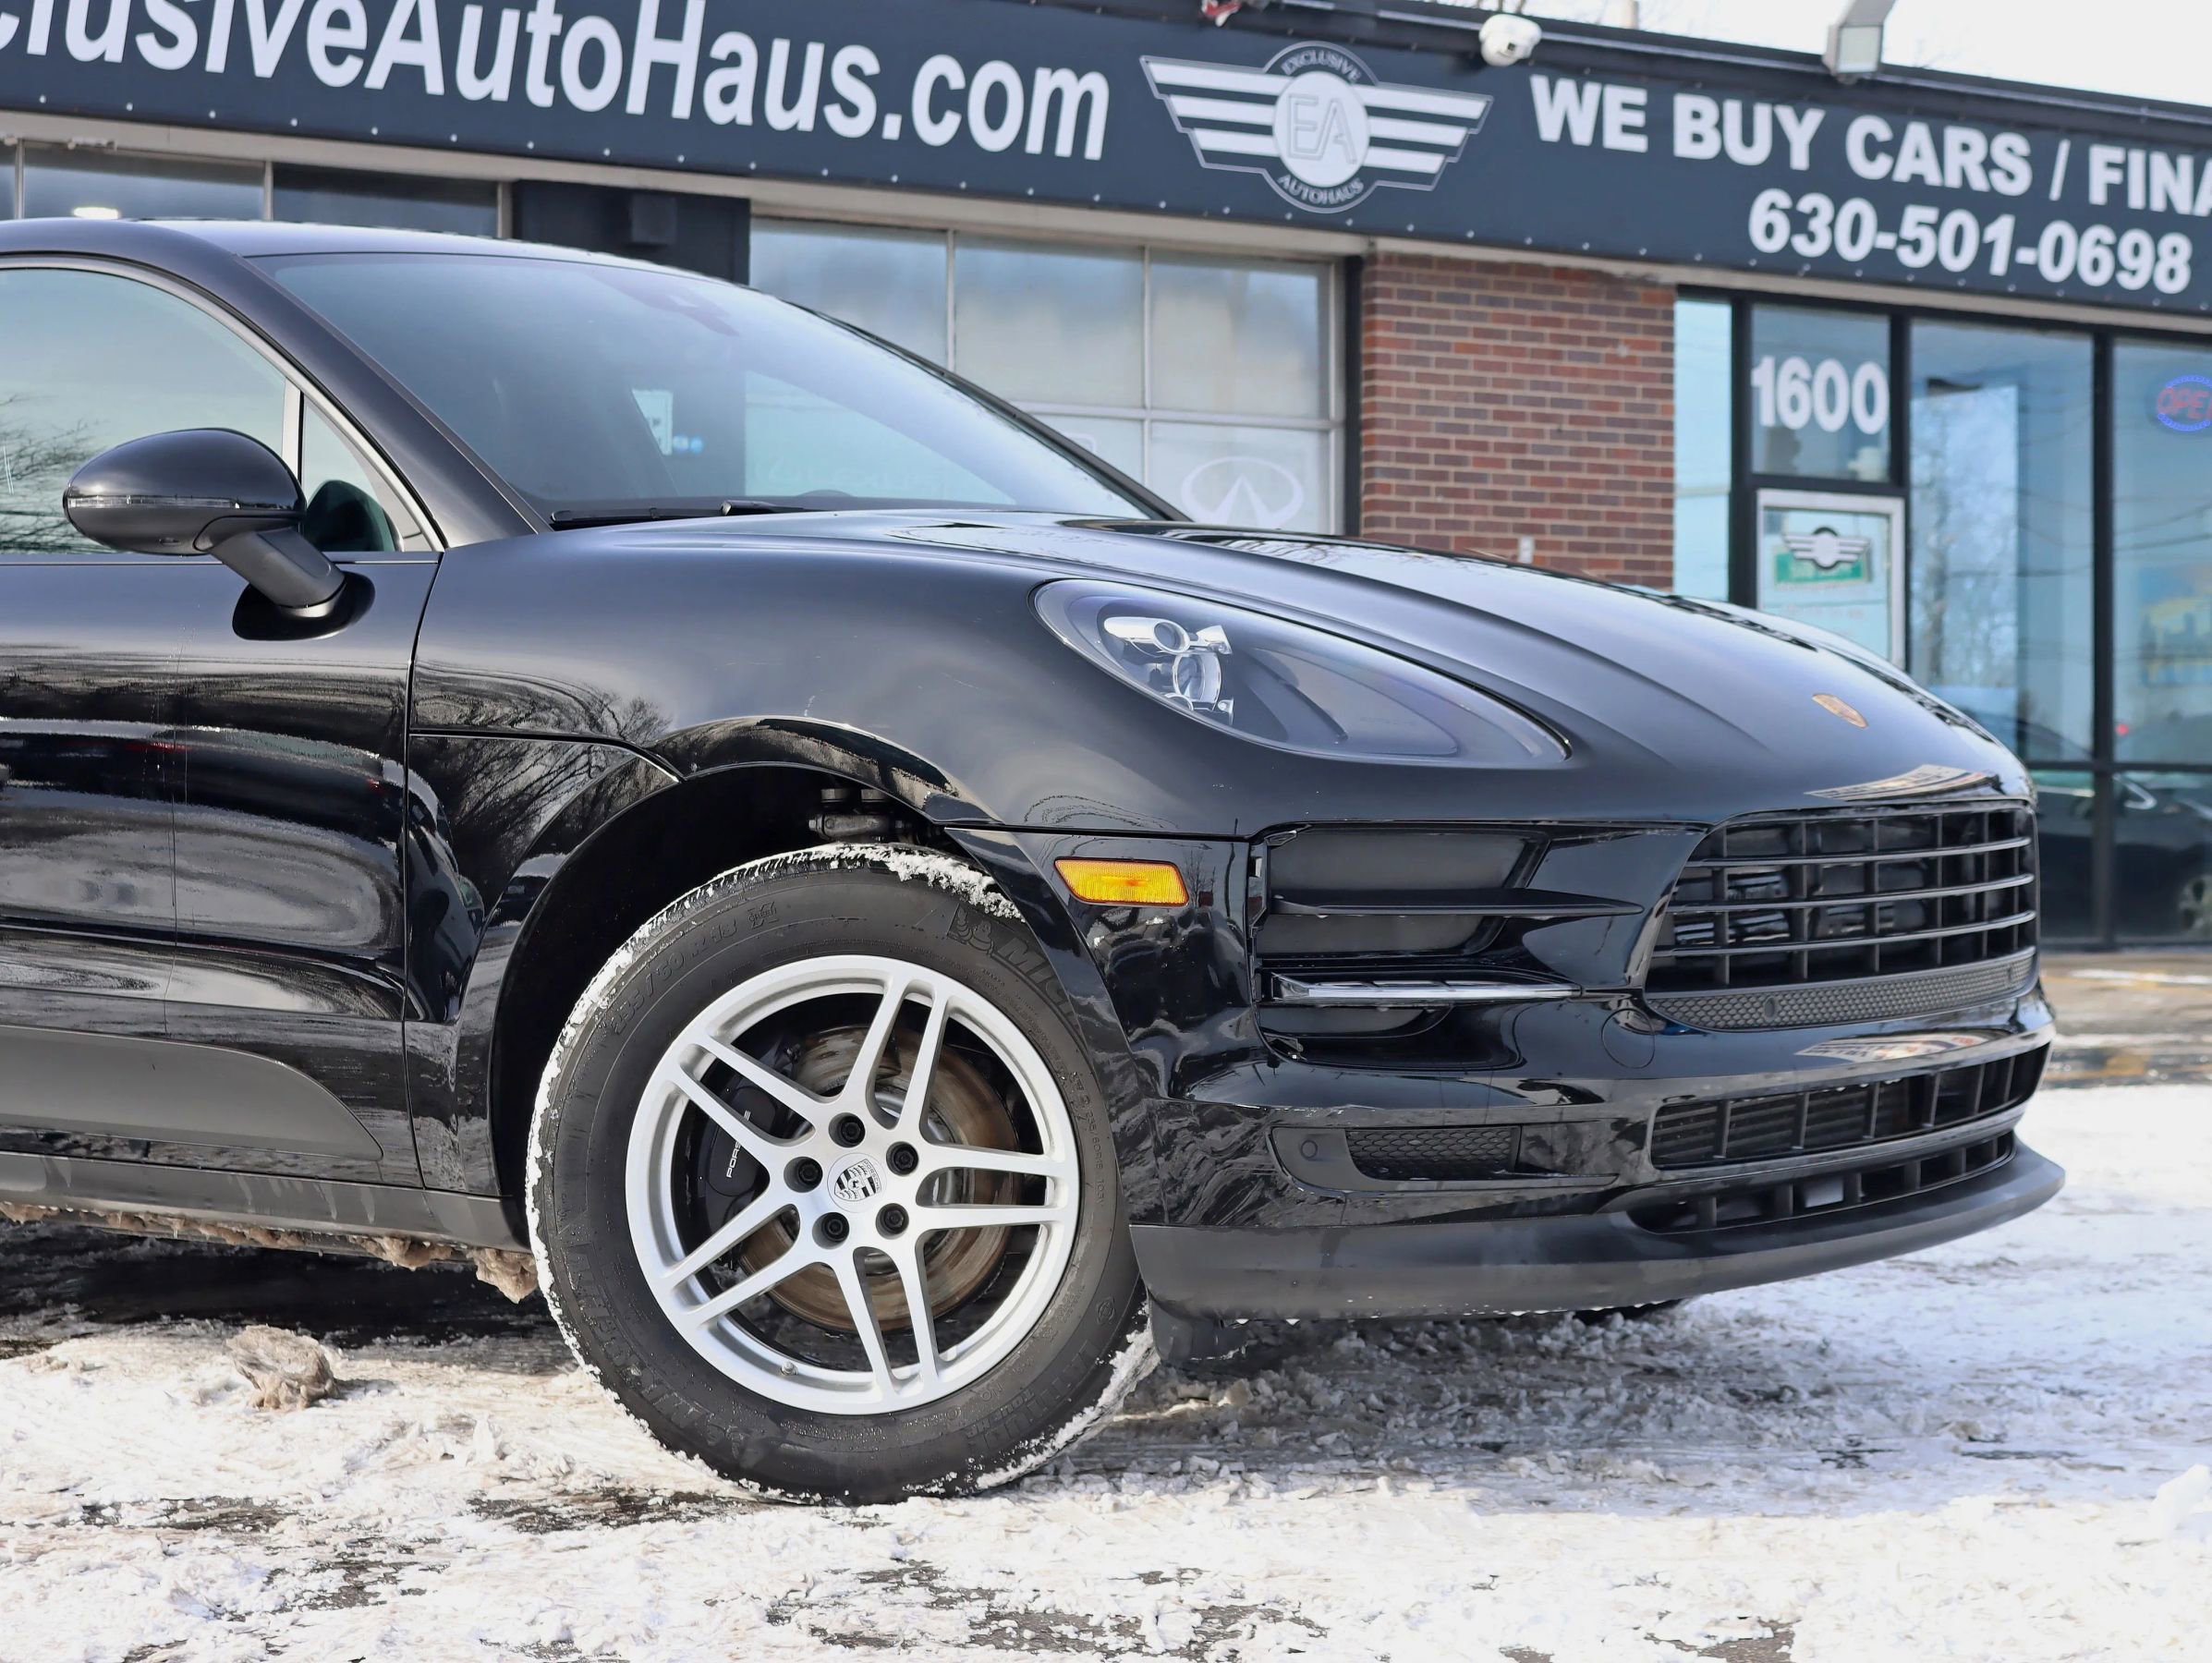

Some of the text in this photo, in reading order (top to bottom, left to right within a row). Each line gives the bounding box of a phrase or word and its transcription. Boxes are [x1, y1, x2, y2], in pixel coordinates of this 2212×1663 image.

[0, 0, 1110, 161] usiveAutoHaus.com
[1281, 49, 1362, 84] EXCLUSIVE
[1287, 93, 1358, 164] EA
[1529, 73, 1649, 153] WE
[1673, 92, 1827, 171] BUY
[1845, 114, 2034, 197] CARS
[2048, 139, 2072, 201] /
[1277, 174, 1365, 204] AUTOHAUS
[1748, 188, 2194, 295] 630-501-0698
[1750, 355, 1890, 435] 1600
[2157, 386, 2212, 419] OPE
